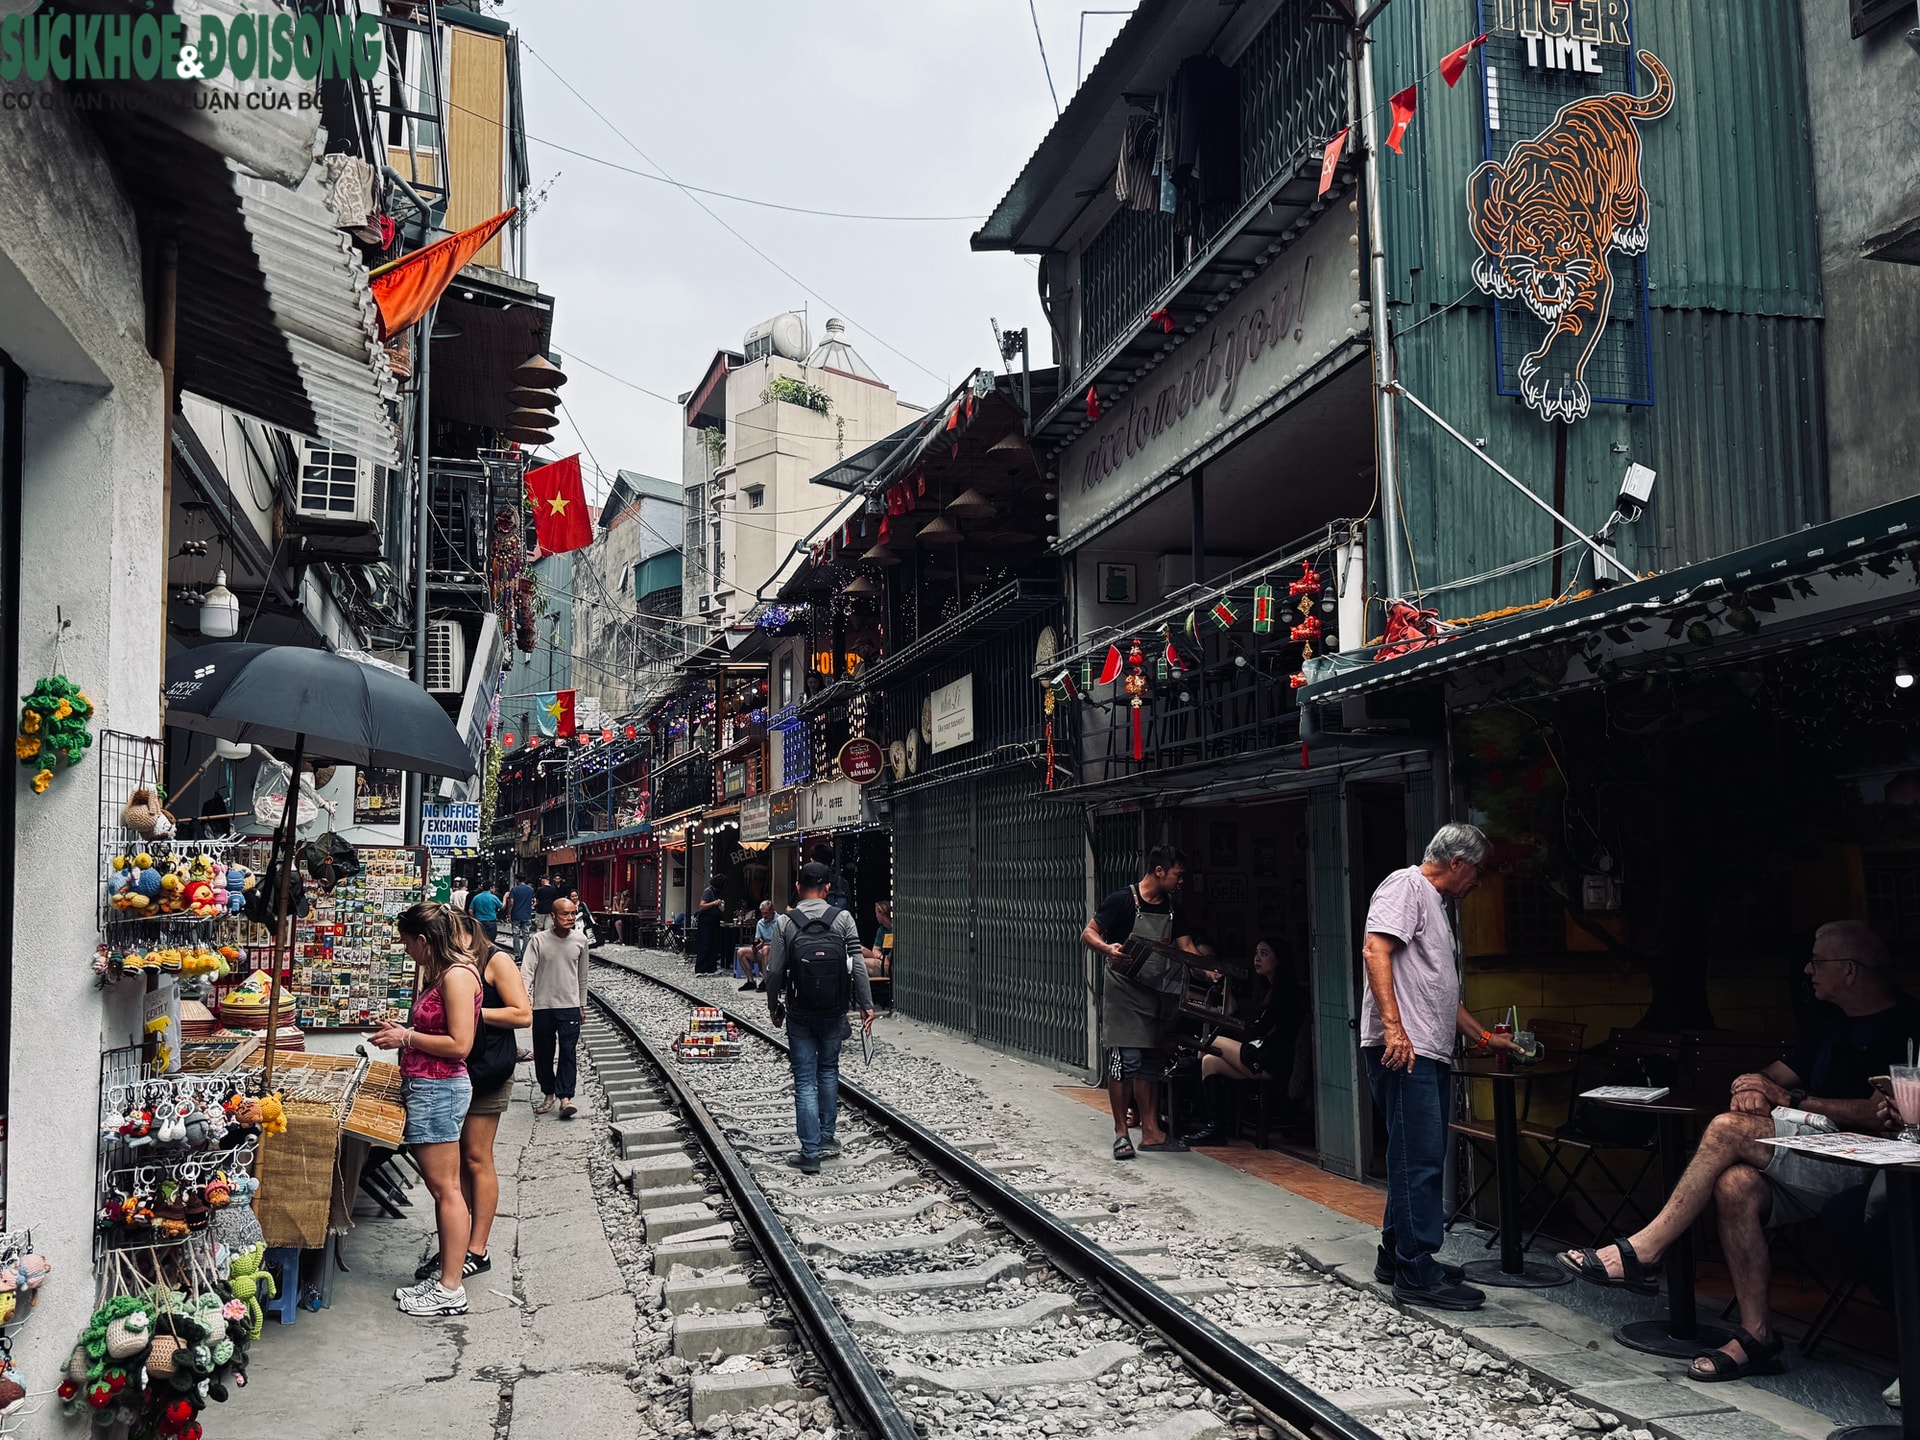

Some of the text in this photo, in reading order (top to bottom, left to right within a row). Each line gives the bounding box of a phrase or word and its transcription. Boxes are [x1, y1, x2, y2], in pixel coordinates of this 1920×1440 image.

[1520, 30, 1603, 73] TIME
[1082, 256, 1313, 493] nice to meet you!
[443, 804, 479, 818] OFFICE
[428, 820, 478, 832] EXCHANGE
[424, 834, 468, 846] CARD 4G
[1211, 886, 1245, 900] OPEN
